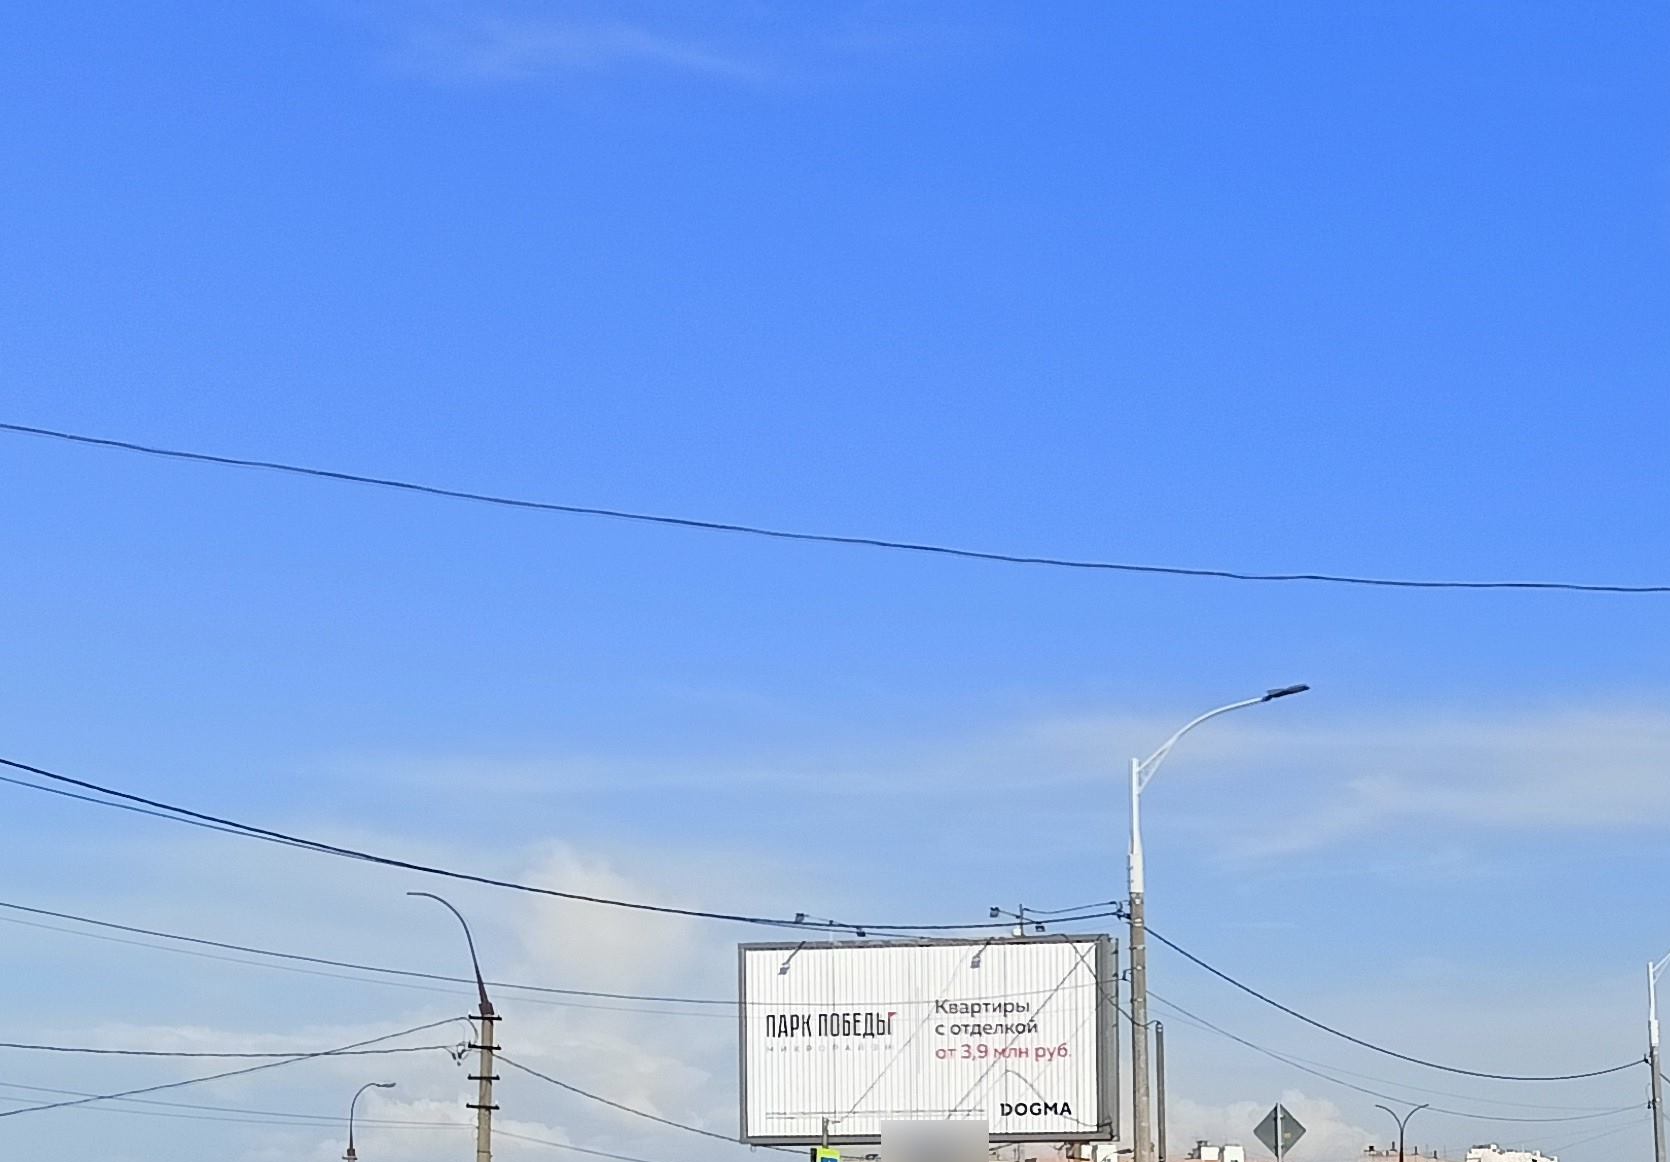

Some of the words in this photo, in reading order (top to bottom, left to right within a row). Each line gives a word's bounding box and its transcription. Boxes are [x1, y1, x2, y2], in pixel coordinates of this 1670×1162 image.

[935, 1000, 1030, 1018] Квартиры
[766, 1014, 812, 1038] ПАРК
[818, 1012, 893, 1038] ПОБЕДЫ
[935, 1024, 945, 1036] с
[950, 1019, 1038, 1037] отделкой
[935, 1048, 956, 1060] от
[961, 1043, 988, 1061] 3,9
[994, 1047, 1029, 1059] млн
[1034, 1042, 1072, 1062] руб.
[1000, 1102, 1072, 1117] DOGMA
